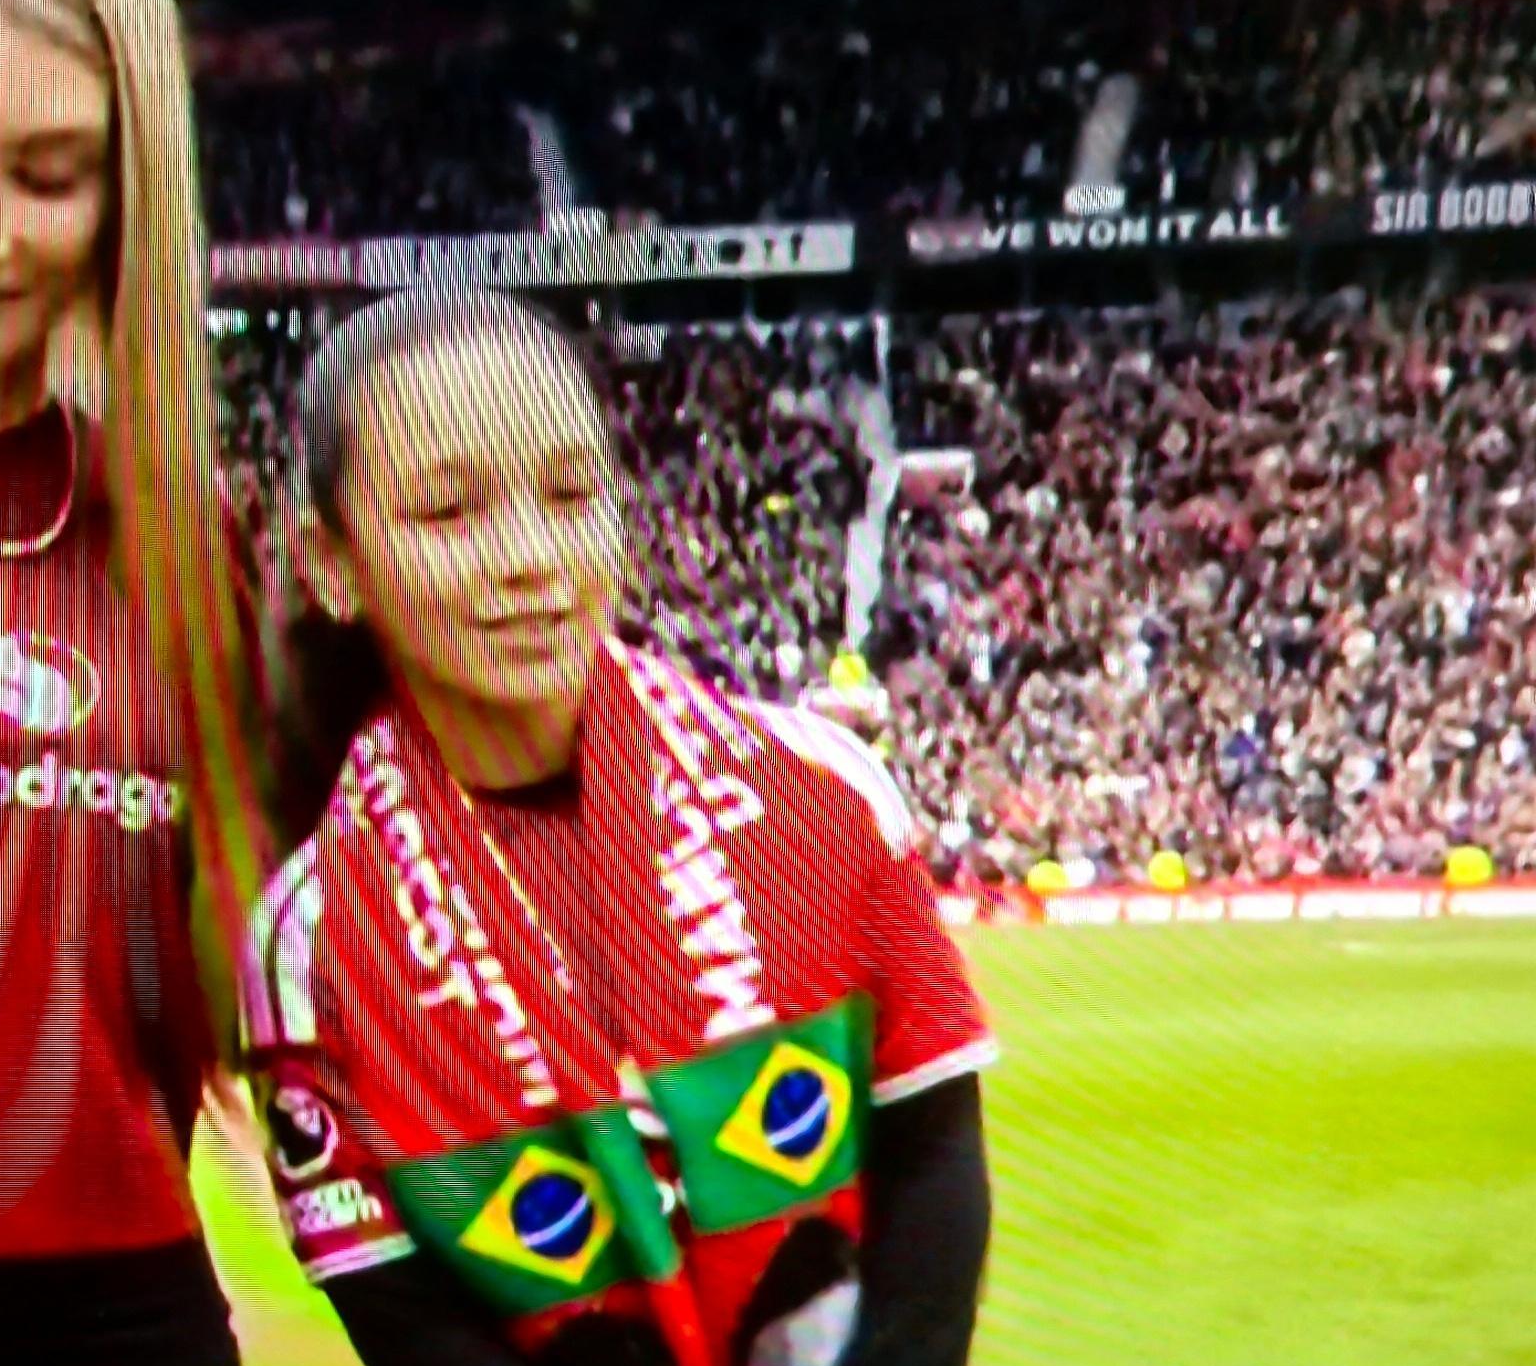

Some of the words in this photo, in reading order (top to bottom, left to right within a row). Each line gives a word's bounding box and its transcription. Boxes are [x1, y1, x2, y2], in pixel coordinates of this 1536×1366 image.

[1048, 218, 1148, 250] WON
[1158, 213, 1199, 242] IT
[1208, 205, 1288, 241] ALL
